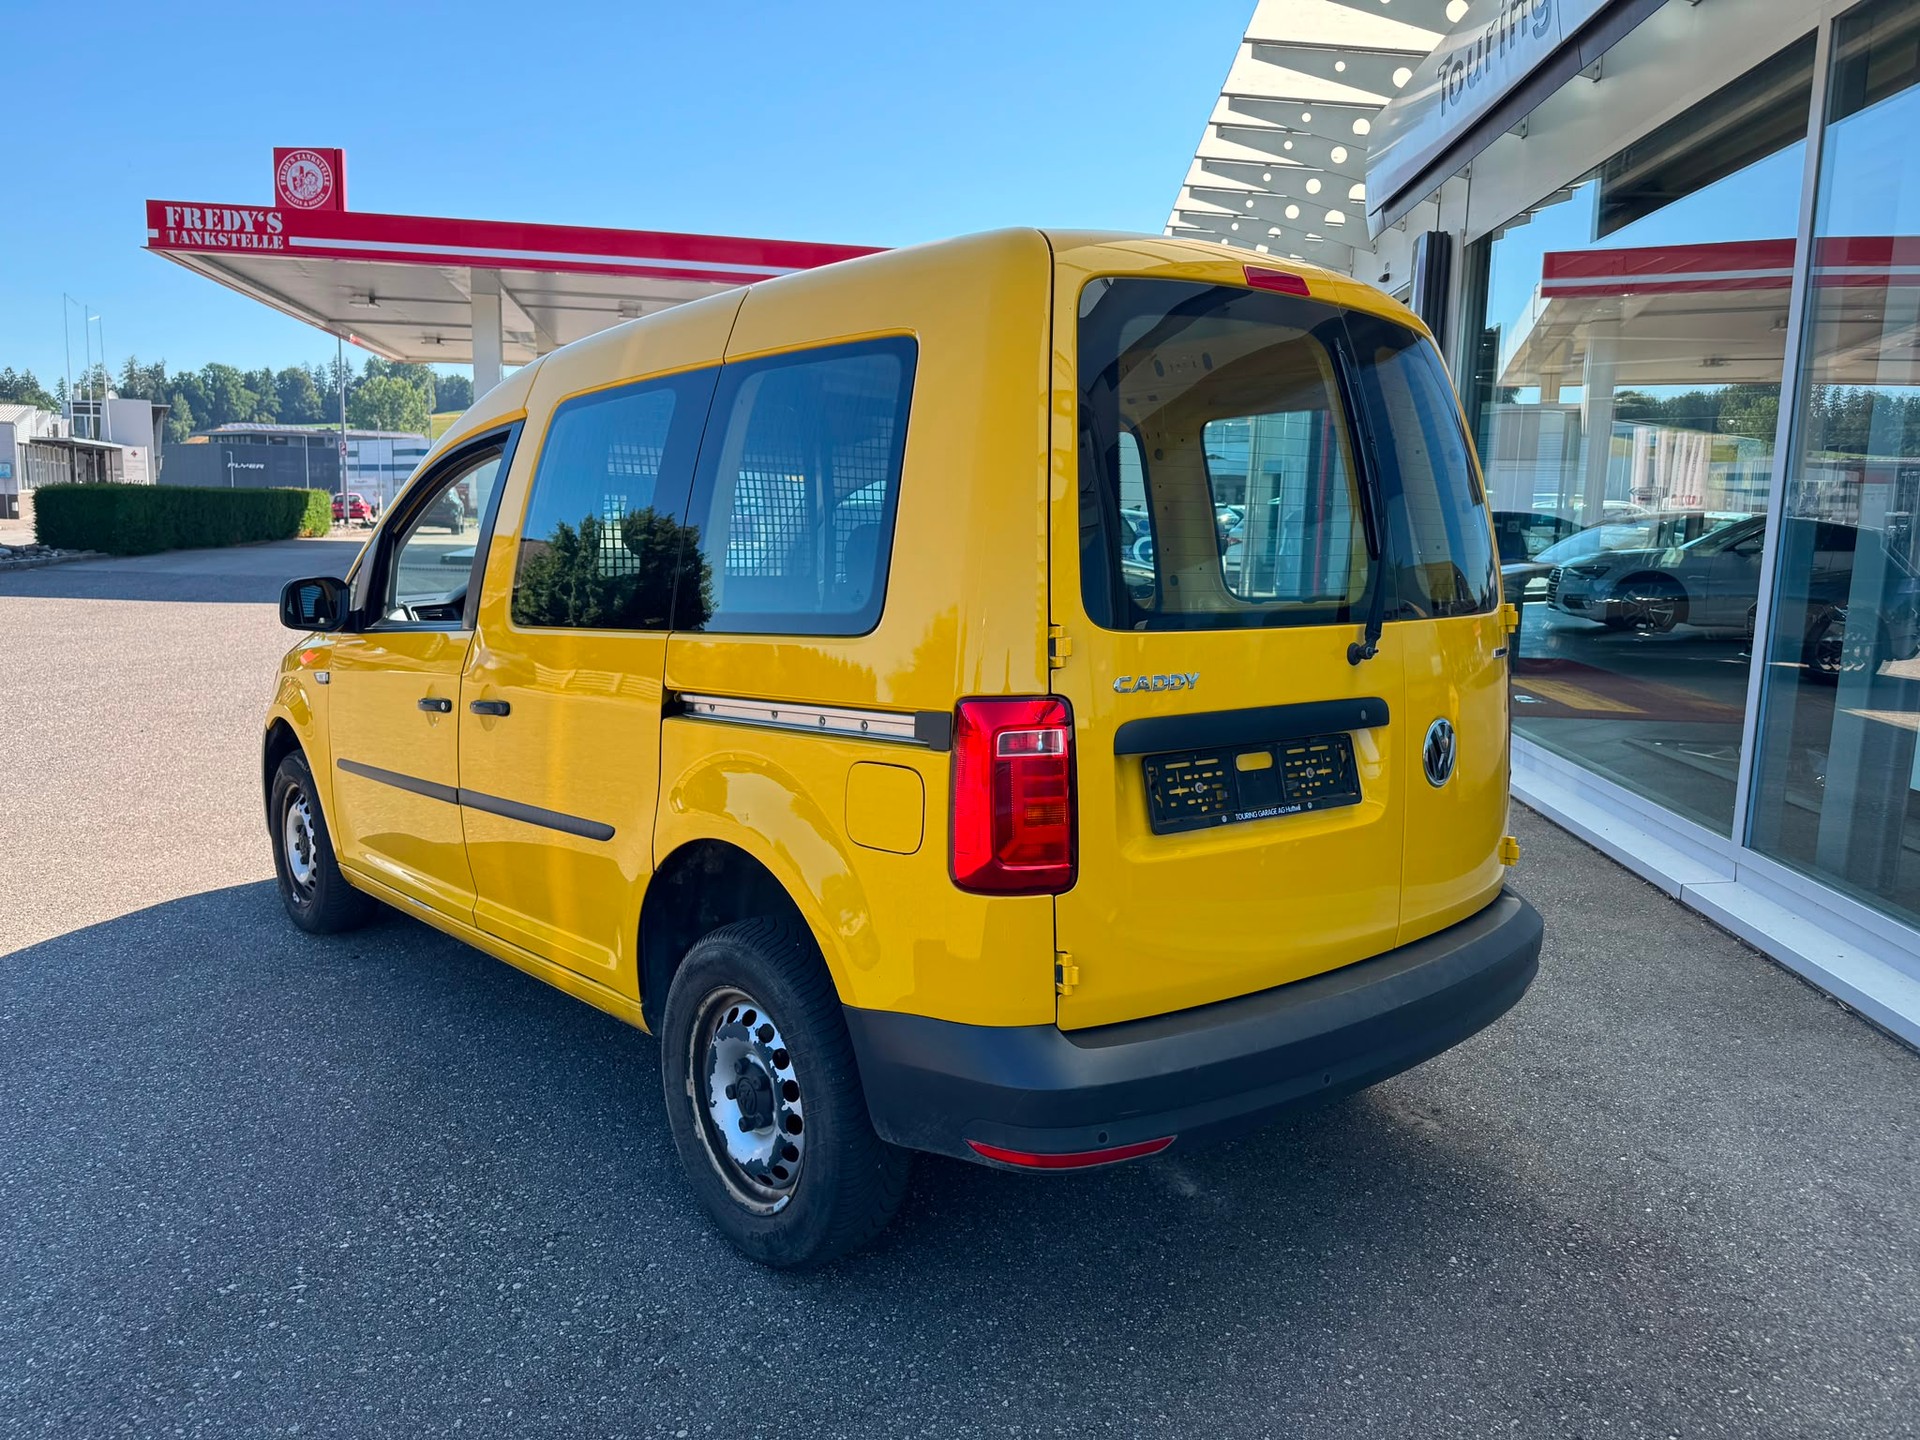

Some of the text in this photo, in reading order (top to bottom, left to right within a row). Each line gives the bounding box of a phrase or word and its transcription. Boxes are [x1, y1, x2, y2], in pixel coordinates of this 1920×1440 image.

[1436, 0, 1551, 117] Touring
[165, 206, 283, 234] FREDY'S
[166, 229, 284, 249] TANKSTELLE
[1112, 672, 1201, 694] CADDY
[1236, 811, 1258, 820] TOURING
[1258, 807, 1278, 817] GARAGE
[1278, 806, 1286, 814] AG
